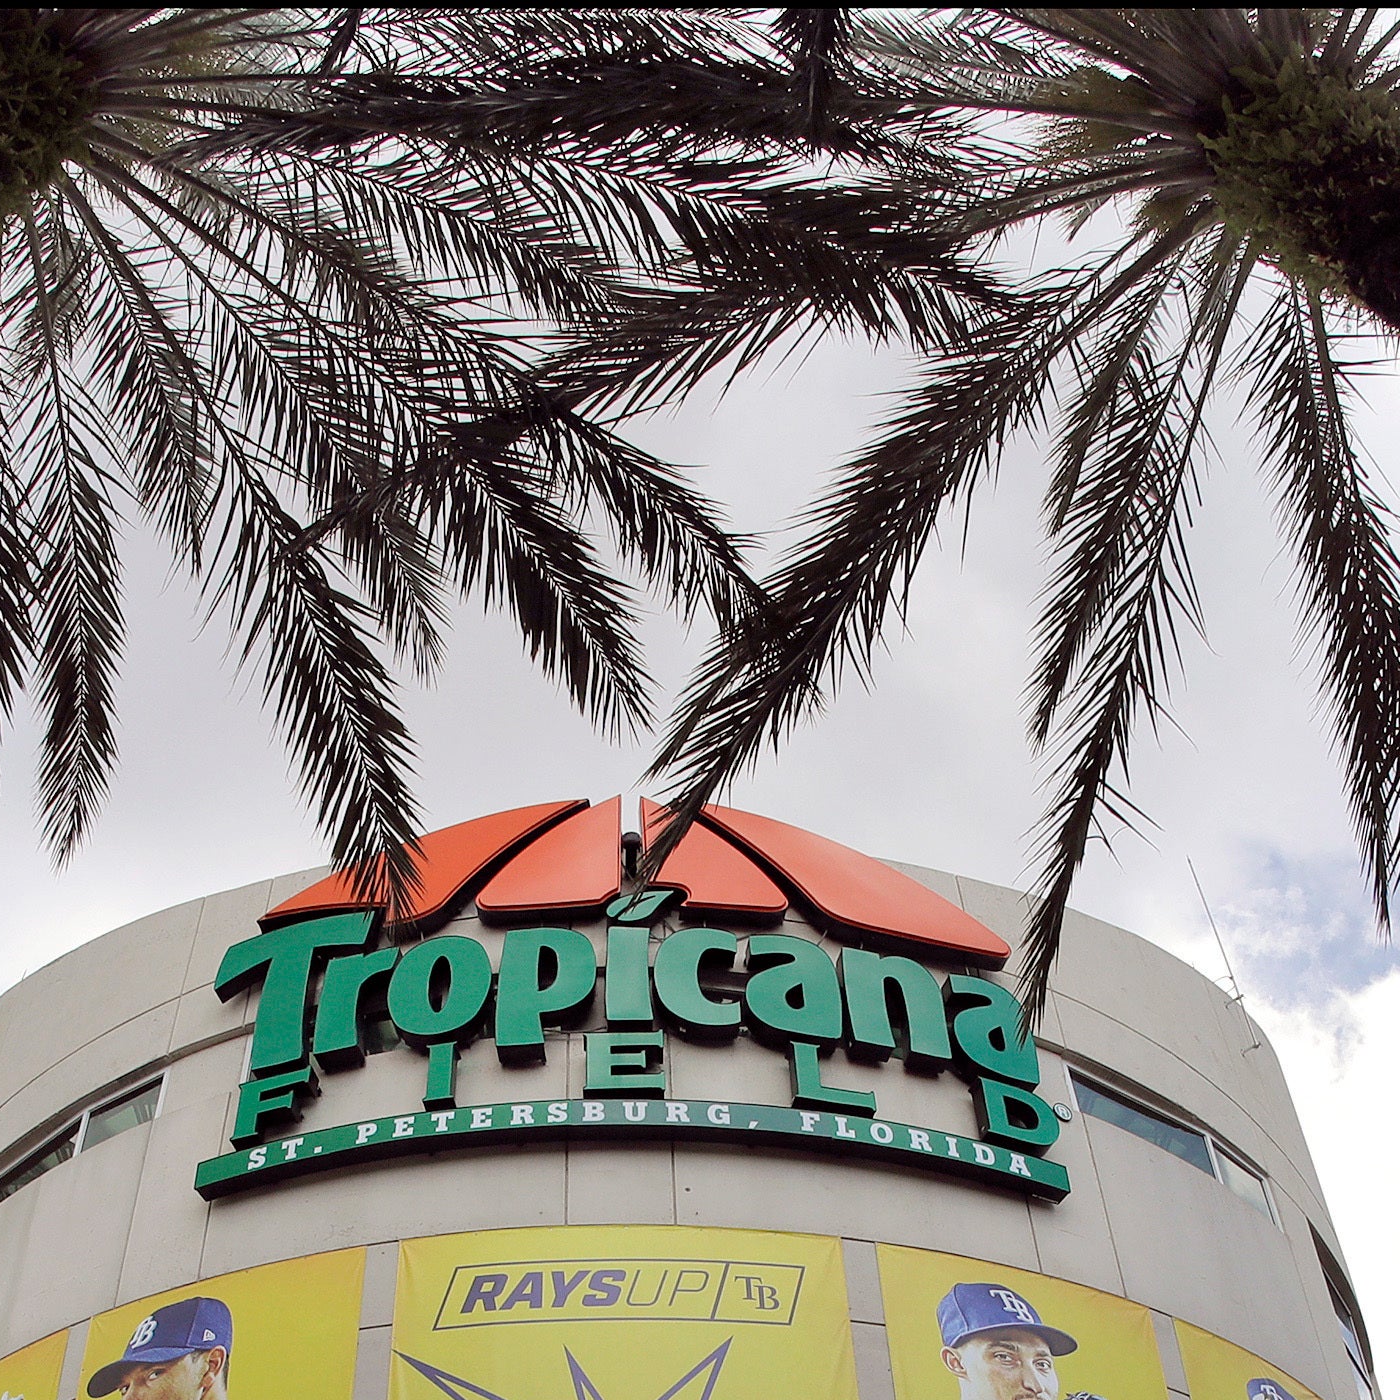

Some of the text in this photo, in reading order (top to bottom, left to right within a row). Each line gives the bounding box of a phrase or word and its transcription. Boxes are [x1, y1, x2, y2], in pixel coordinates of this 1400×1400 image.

[213, 891, 1041, 1087] Tropicana
[230, 1029, 1061, 1147] FIELD
[247, 1101, 1033, 1178] ST. PETERSBURG, FLORIDA
[734, 1274, 781, 1311] TB
